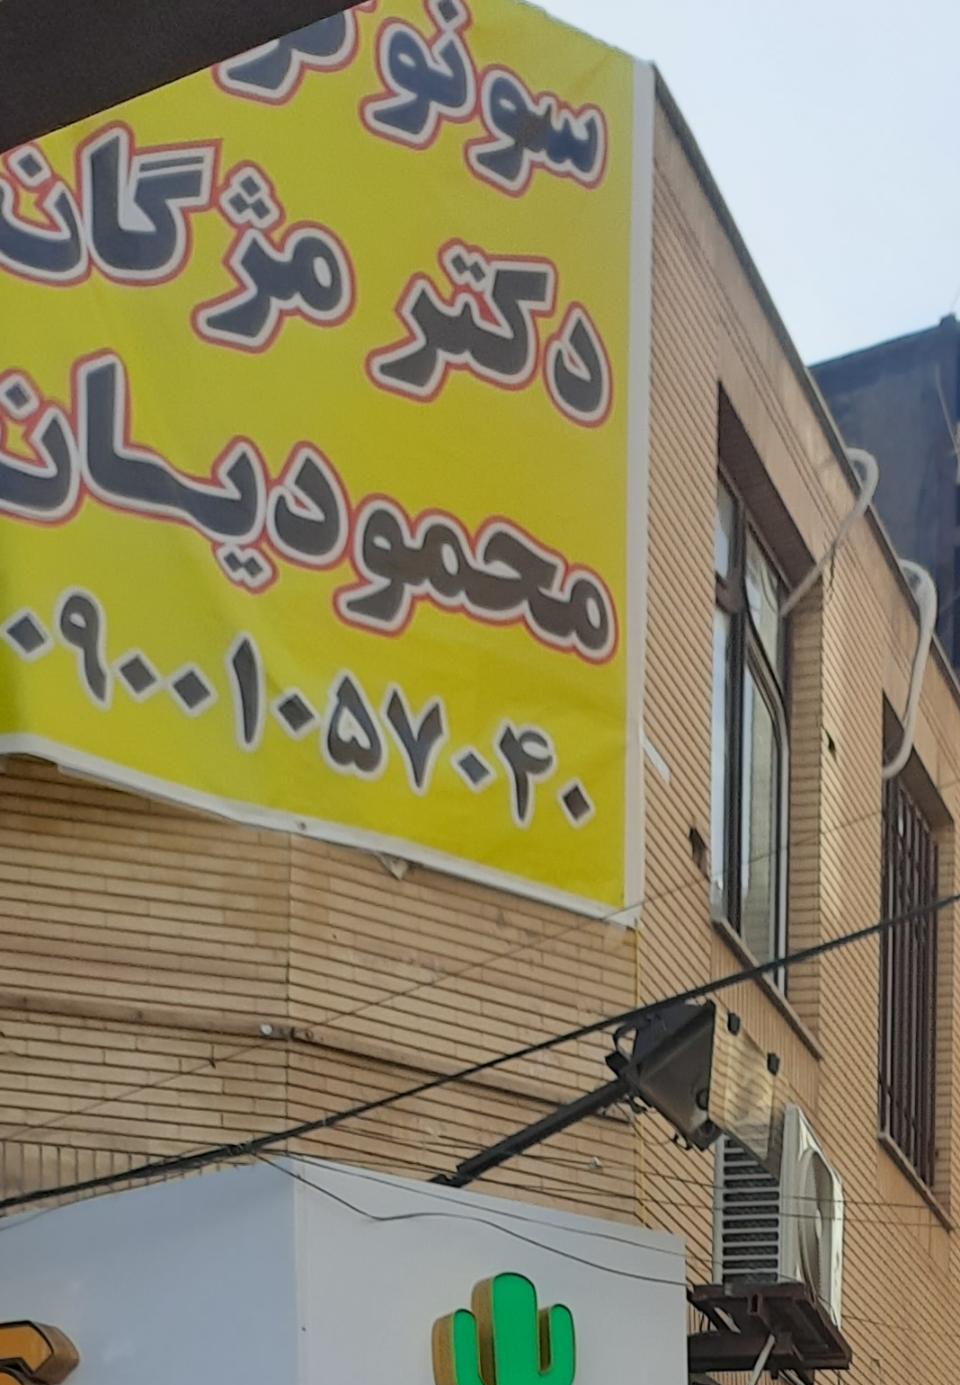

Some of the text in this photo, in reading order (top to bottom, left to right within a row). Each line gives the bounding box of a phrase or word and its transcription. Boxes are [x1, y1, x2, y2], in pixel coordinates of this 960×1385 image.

[0, 128, 606, 419] دکتر مژگان
[0, 360, 611, 656] محمودیان
[6, 592, 595, 823] ۰۹۰۰۱۰۵۷۰۴۰
